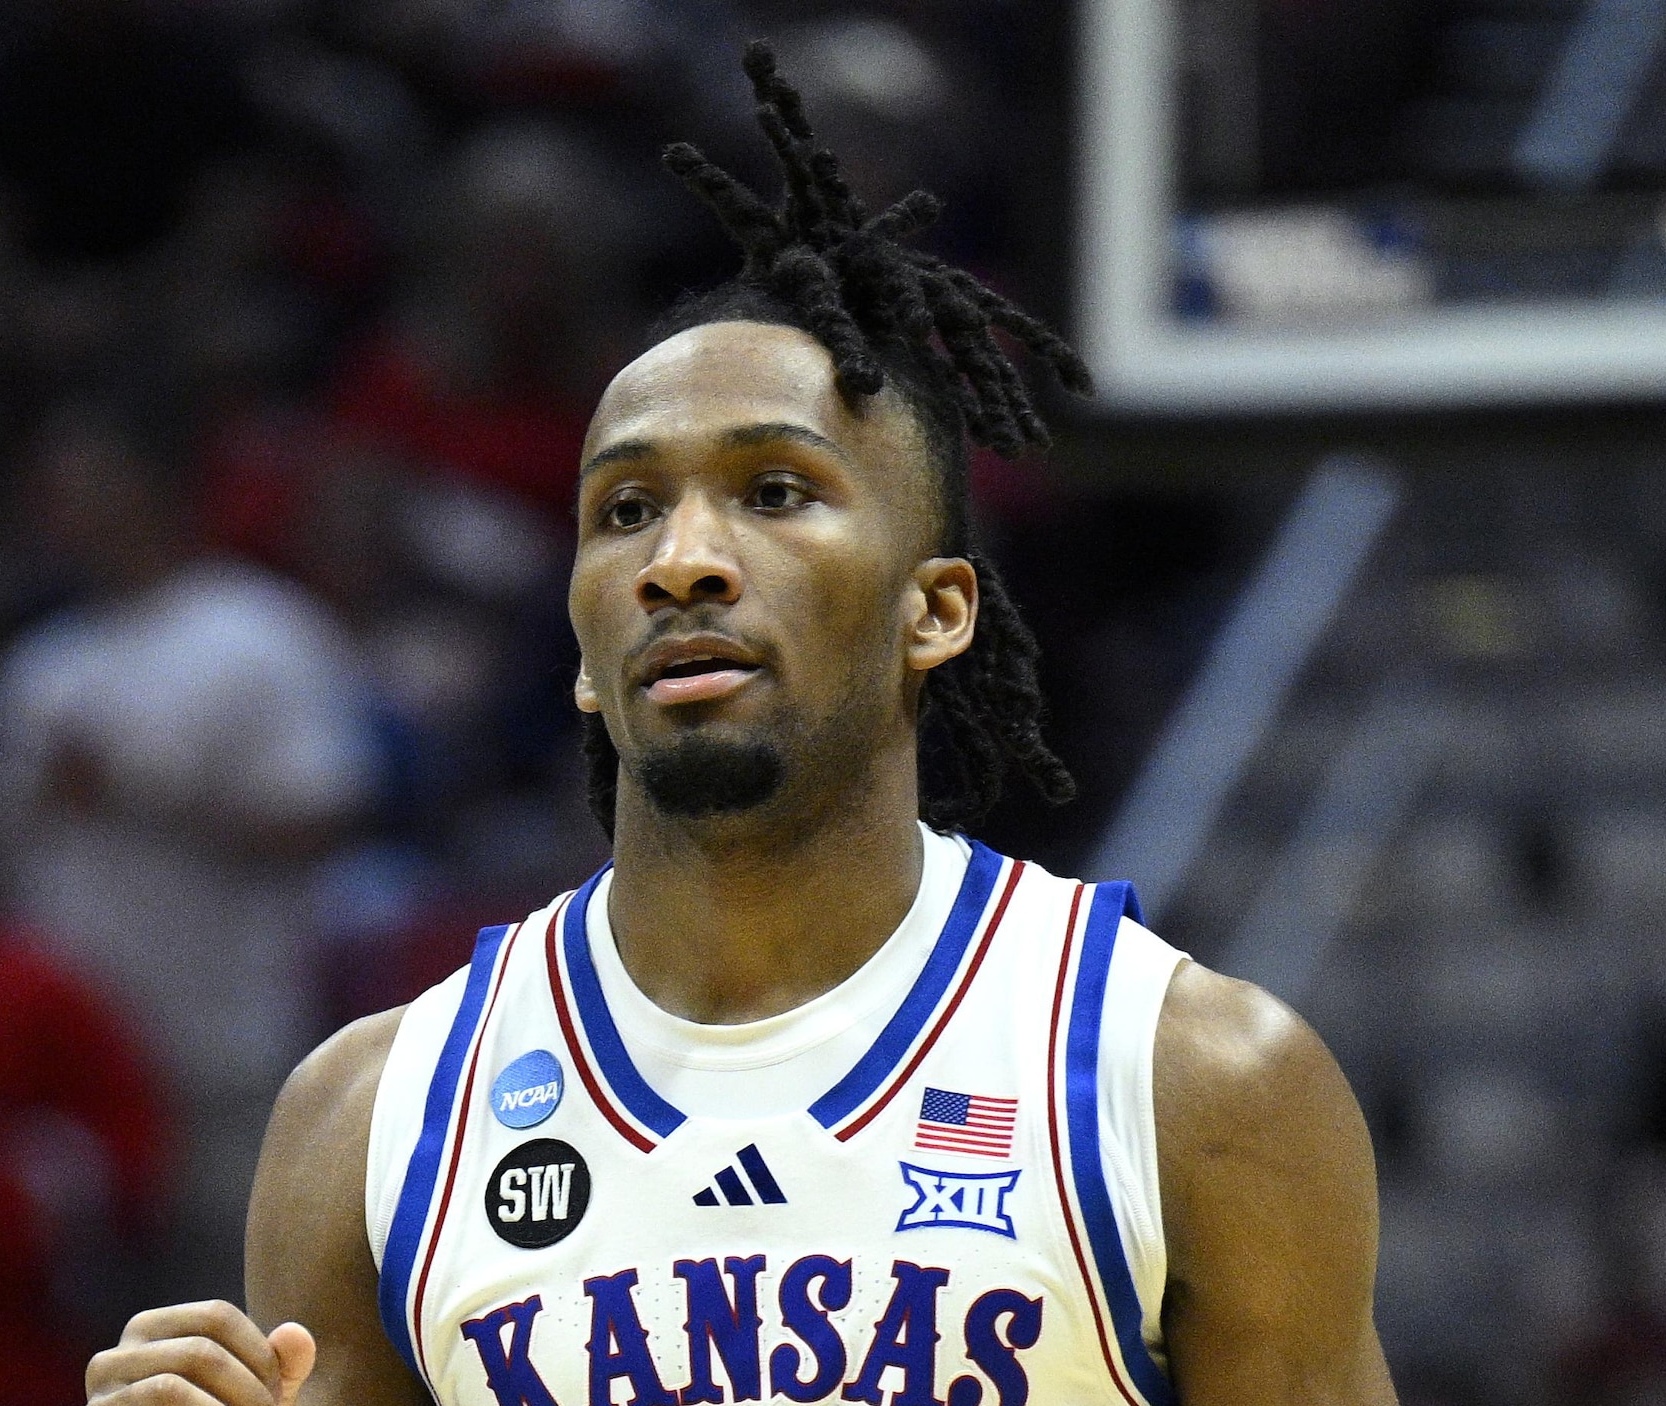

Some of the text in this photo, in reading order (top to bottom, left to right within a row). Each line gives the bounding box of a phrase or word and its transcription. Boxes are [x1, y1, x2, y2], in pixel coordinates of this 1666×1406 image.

[500, 1081, 558, 1111] NCAA
[498, 1163, 575, 1222] SW
[895, 1161, 1021, 1239] XII
